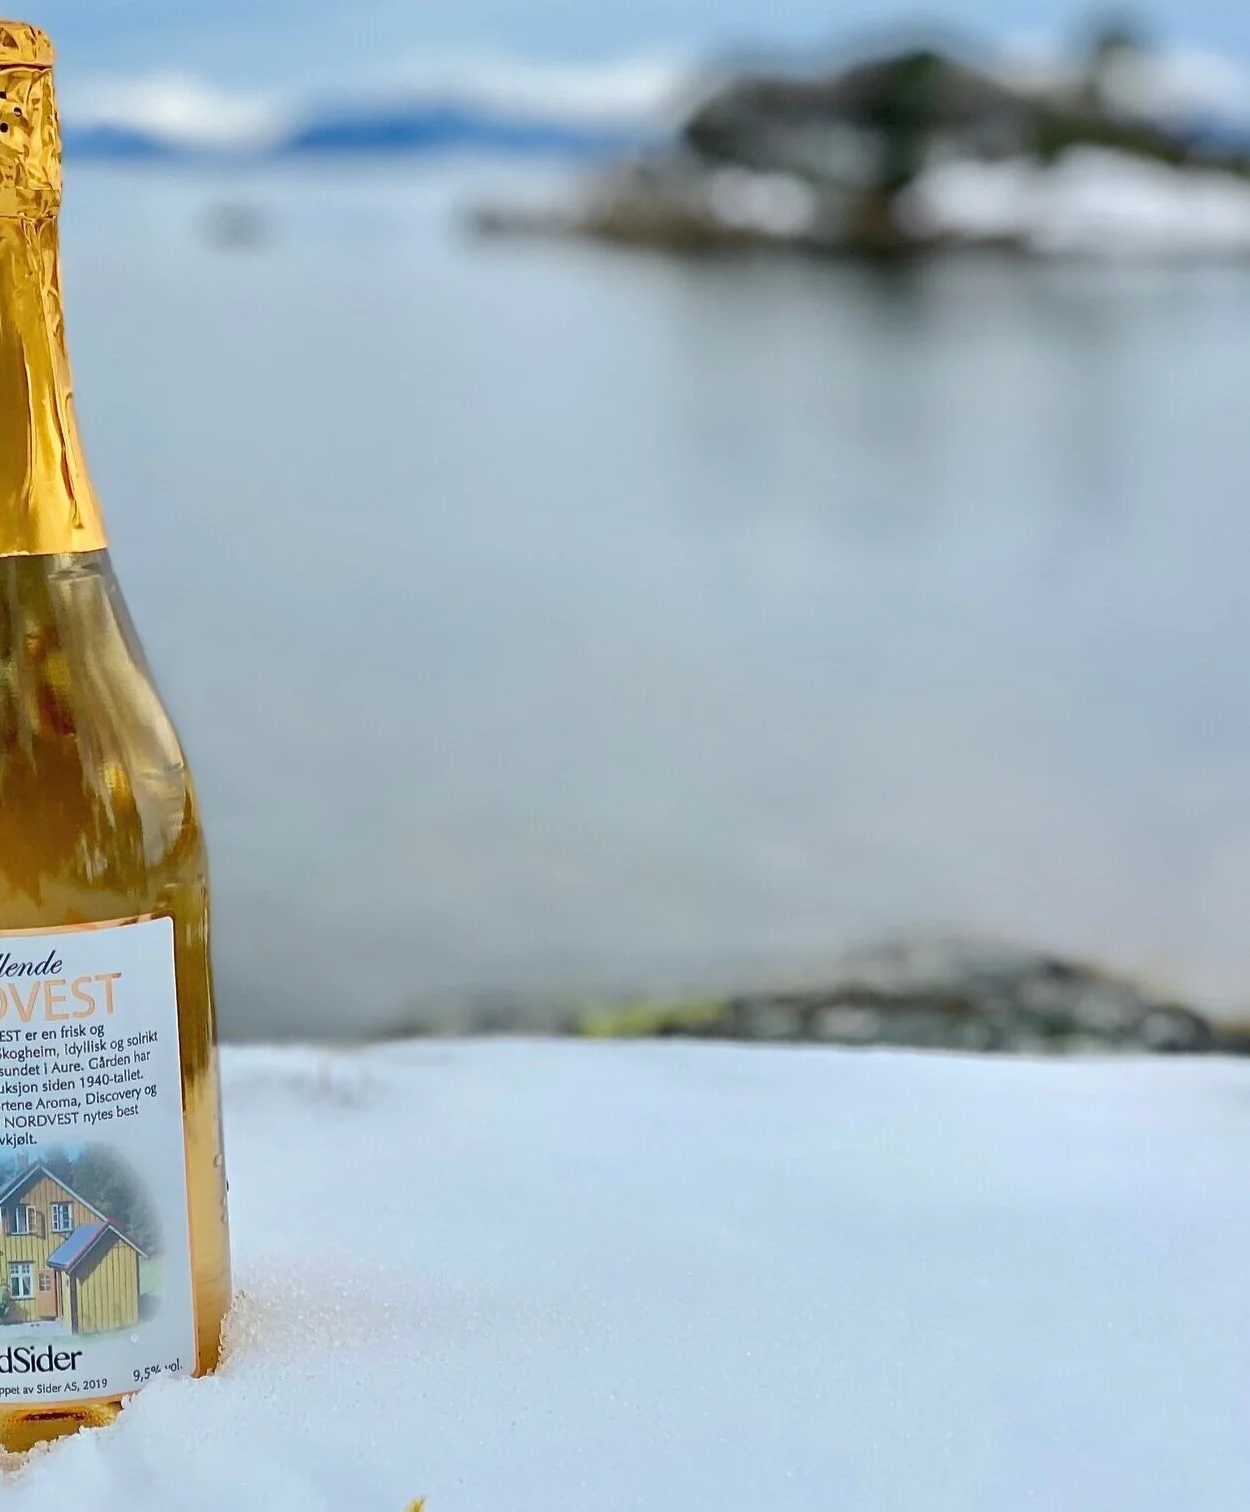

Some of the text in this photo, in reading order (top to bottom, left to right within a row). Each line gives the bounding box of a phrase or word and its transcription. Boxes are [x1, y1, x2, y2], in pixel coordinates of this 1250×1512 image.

[25, 1032, 37, 1041] er
[42, 1030, 56, 1040] en
[60, 1024, 86, 1038] frisk
[90, 1024, 104, 1038] og
[65, 1039, 106, 1057] idyllisk
[110, 1039, 124, 1051] og
[127, 1030, 158, 1046] solrikt
[44, 1062, 47, 1074] i
[51, 1062, 84, 1074] Aure.
[88, 1056, 130, 1070] Gården
[134, 1051, 150, 1062] har
[42, 1080, 75, 1092] siden
[80, 1069, 144, 1088] 1940-tallet.
[36, 1098, 81, 1110] Aroma,
[86, 1087, 141, 1105] Discovery
[144, 1084, 157, 1097] og
[5, 1112, 79, 1128] NORDVEST
[83, 1111, 113, 1125] nytes
[117, 1104, 139, 1117] best
[23, 1386, 33, 1394] av
[37, 1383, 61, 1394] Sider
[64, 1382, 80, 1392] AS,
[83, 1378, 108, 1390] 2019
